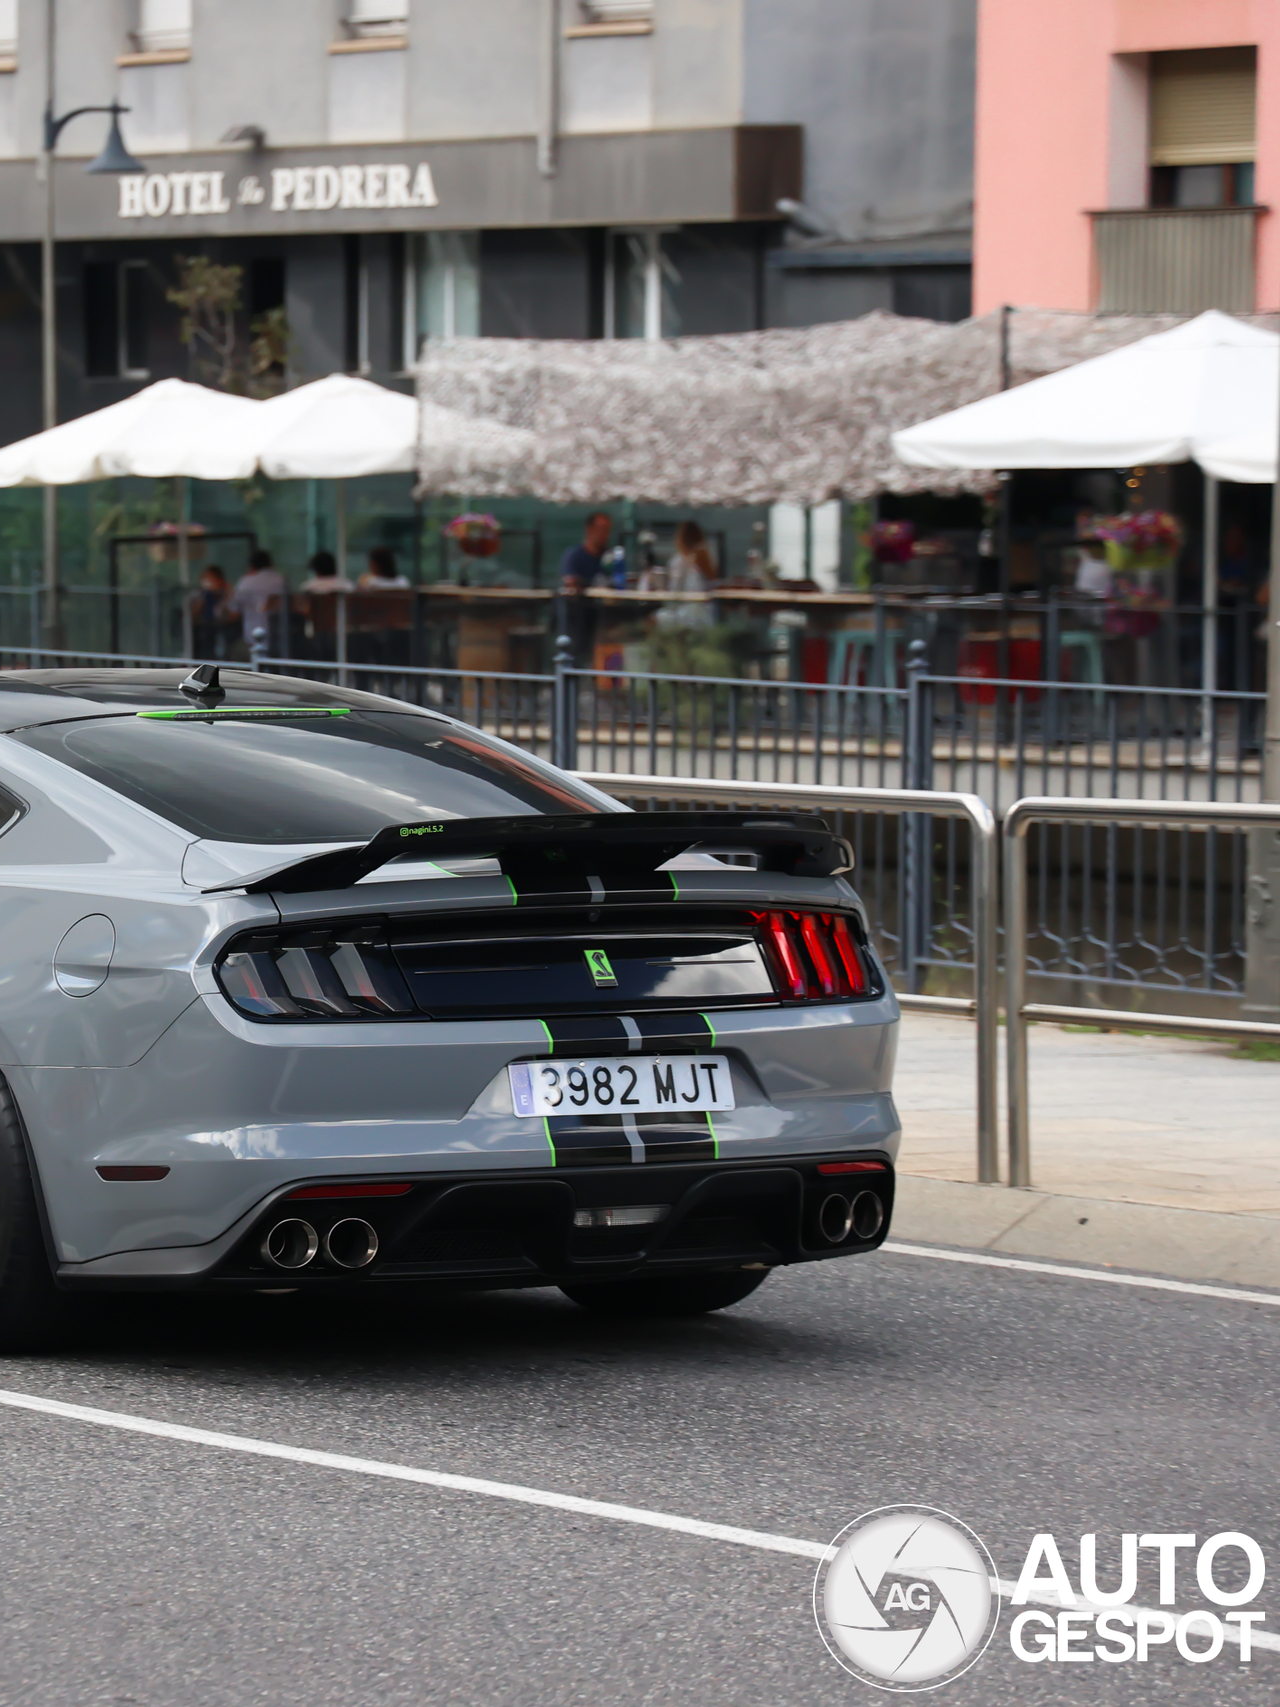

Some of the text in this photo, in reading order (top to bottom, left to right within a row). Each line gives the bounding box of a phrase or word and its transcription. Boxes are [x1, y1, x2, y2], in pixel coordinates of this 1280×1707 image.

[118, 171, 230, 218] HOTEL
[271, 162, 438, 211] PEDRERA
[520, 1063, 719, 1107] E 3982 MJT
